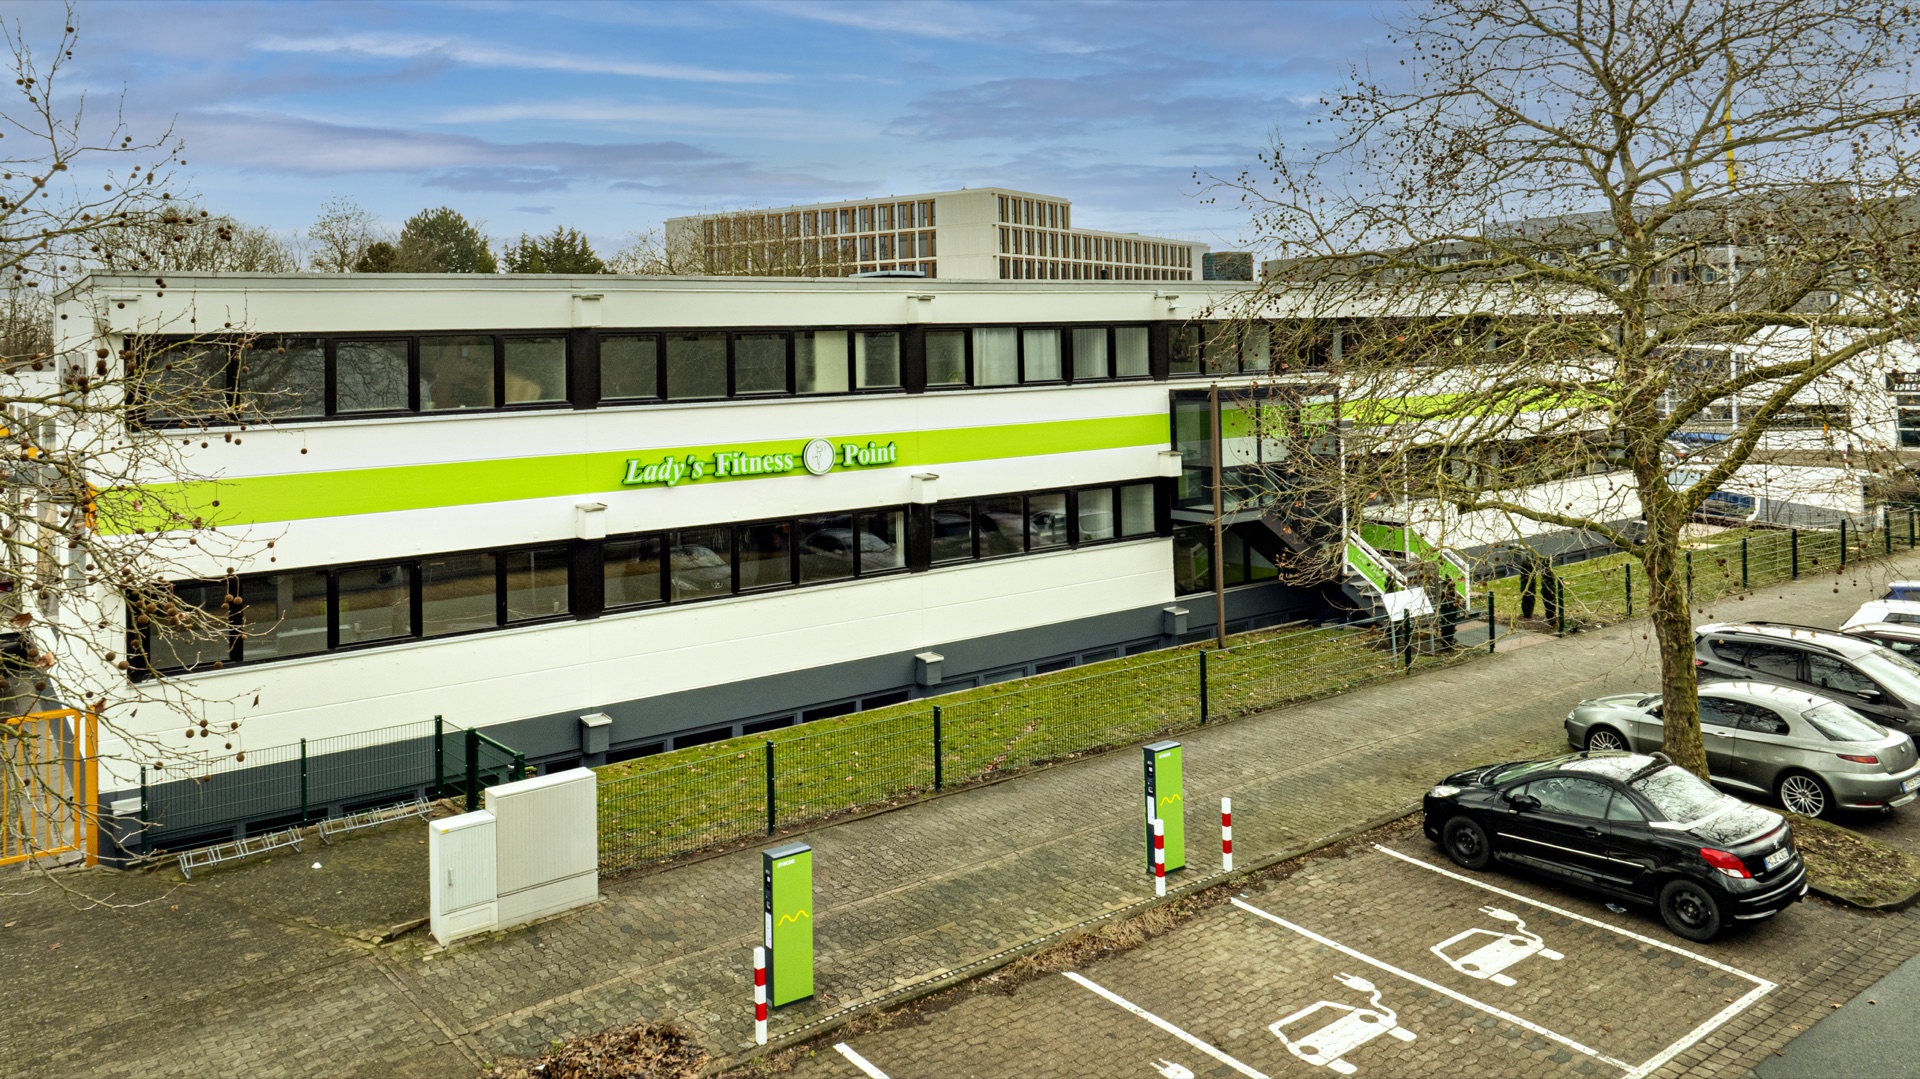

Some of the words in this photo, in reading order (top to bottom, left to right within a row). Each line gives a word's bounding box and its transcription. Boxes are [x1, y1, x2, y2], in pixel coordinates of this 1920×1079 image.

[623, 454, 705, 487] Lady's
[713, 450, 795, 478] Fitness
[842, 440, 898, 467] Point
